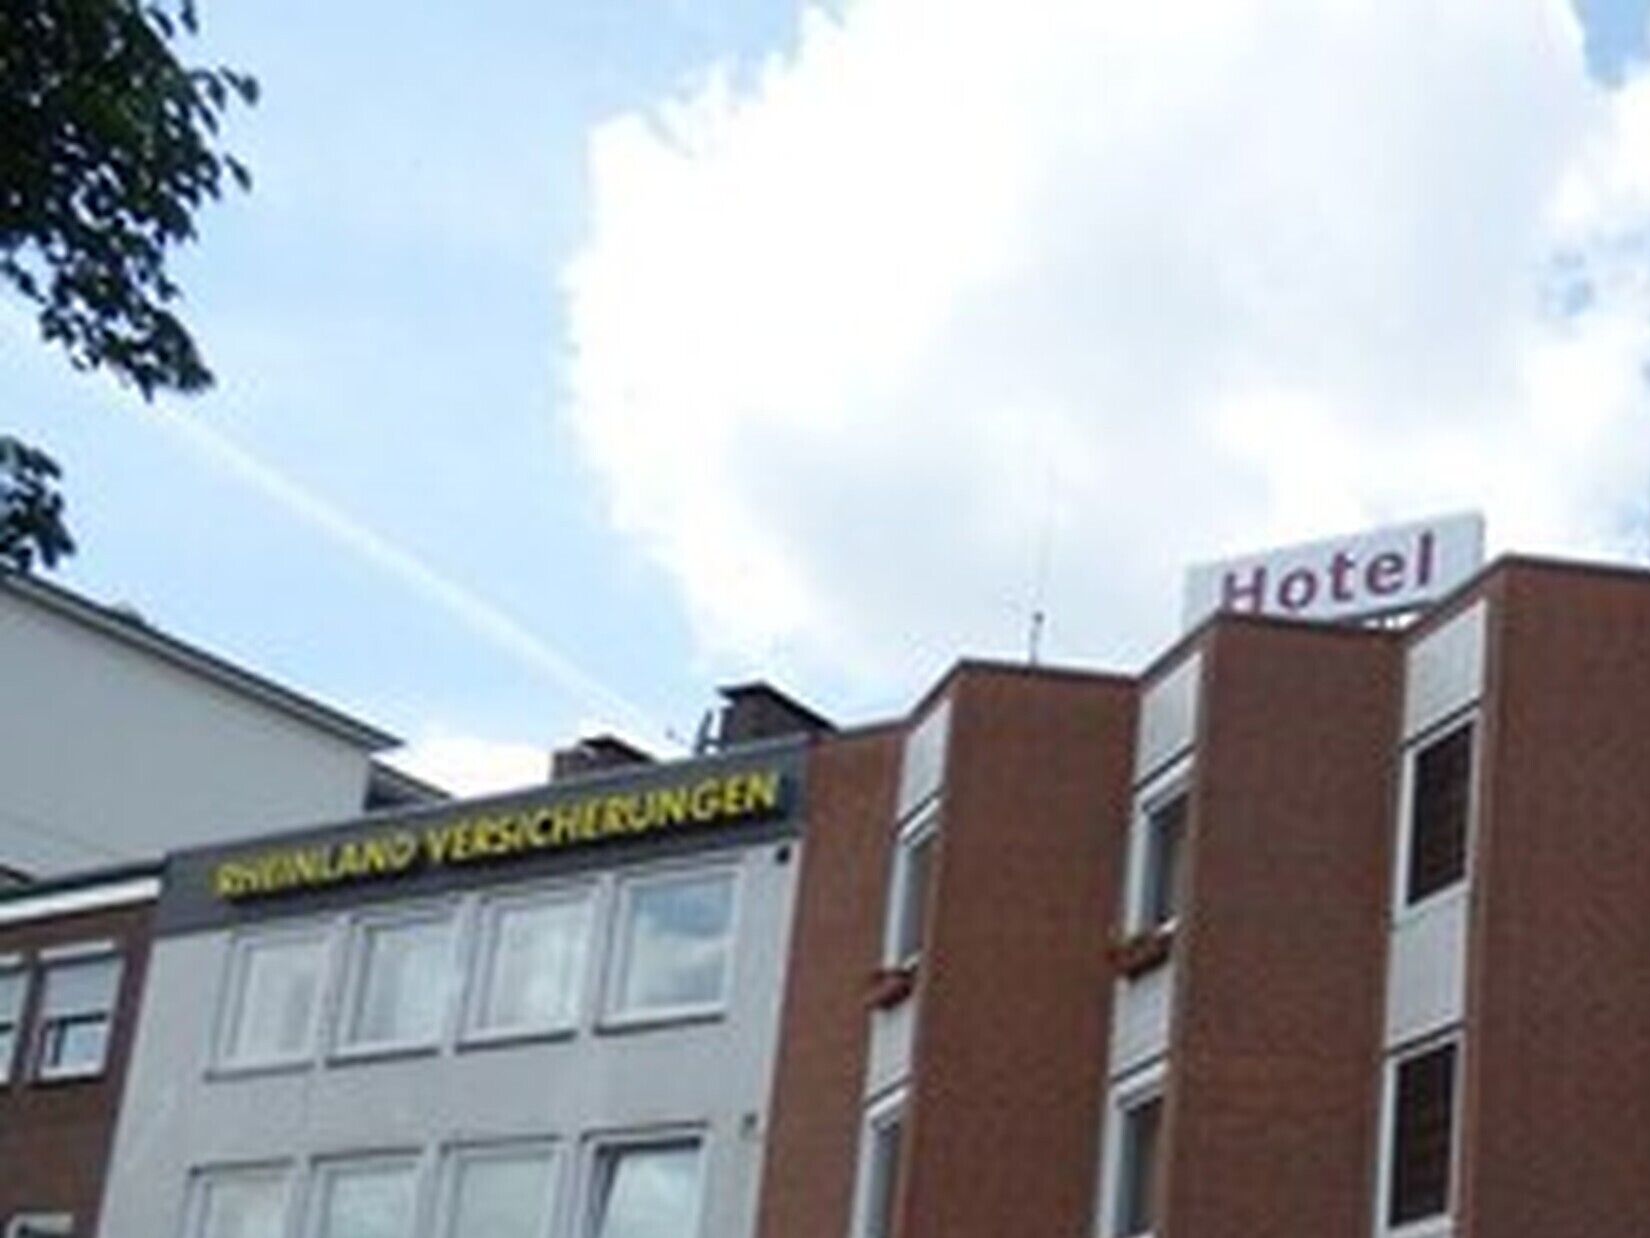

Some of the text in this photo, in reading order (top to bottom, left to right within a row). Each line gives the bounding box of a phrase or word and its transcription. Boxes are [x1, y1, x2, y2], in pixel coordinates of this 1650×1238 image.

[1223, 531, 1434, 612] Hotel
[213, 770, 778, 899] RHEINLAND VERSICHERUNGEN
